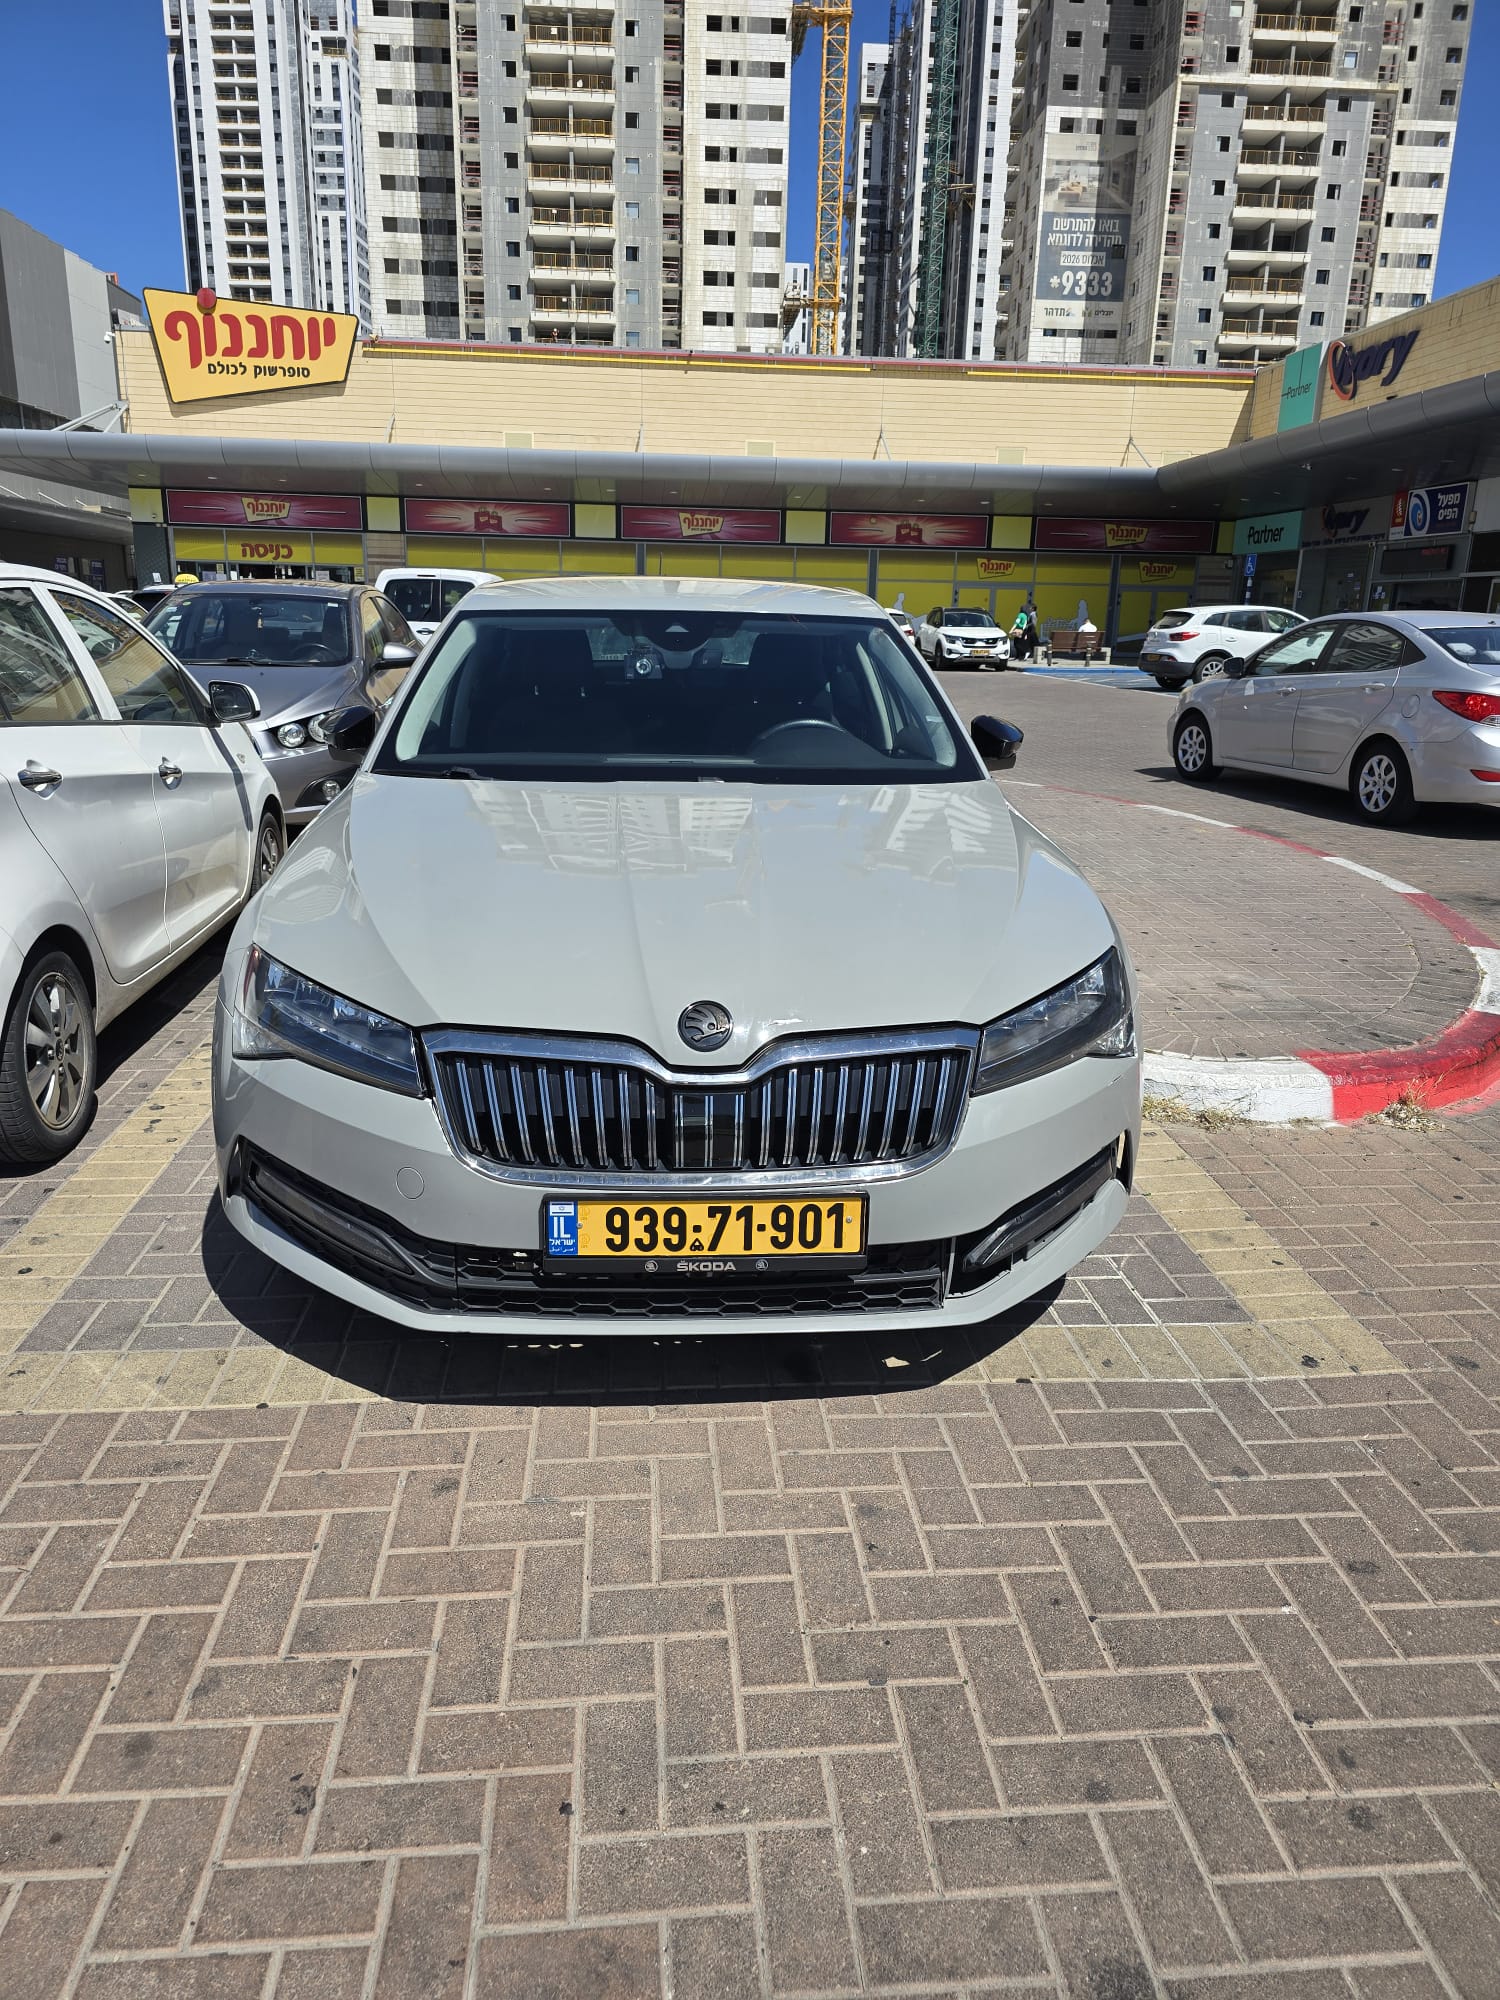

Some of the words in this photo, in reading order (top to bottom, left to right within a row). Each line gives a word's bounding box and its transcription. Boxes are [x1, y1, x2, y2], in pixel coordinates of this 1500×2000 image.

[1052, 216, 1097, 232] להתרשם
[1099, 218, 1120, 233] בואו
[1047, 232, 1084, 247] לדוגמא
[1062, 254, 1081, 264] 2026
[164, 308, 337, 369] יוחננוף
[207, 360, 247, 375] לכולם
[253, 363, 311, 379] סופרשוק
[1282, 382, 1313, 400] Partner
[1437, 491, 1461, 508] מפעל
[246, 501, 286, 515] יוחננוף
[1437, 507, 1459, 521] הפיס
[1247, 525, 1285, 545] Partner
[240, 542, 294, 561] כניסה
[553, 1216, 571, 1239] IL
[549, 1238, 576, 1246] ישראל
[676, 1259, 737, 1272] ŠKODA
